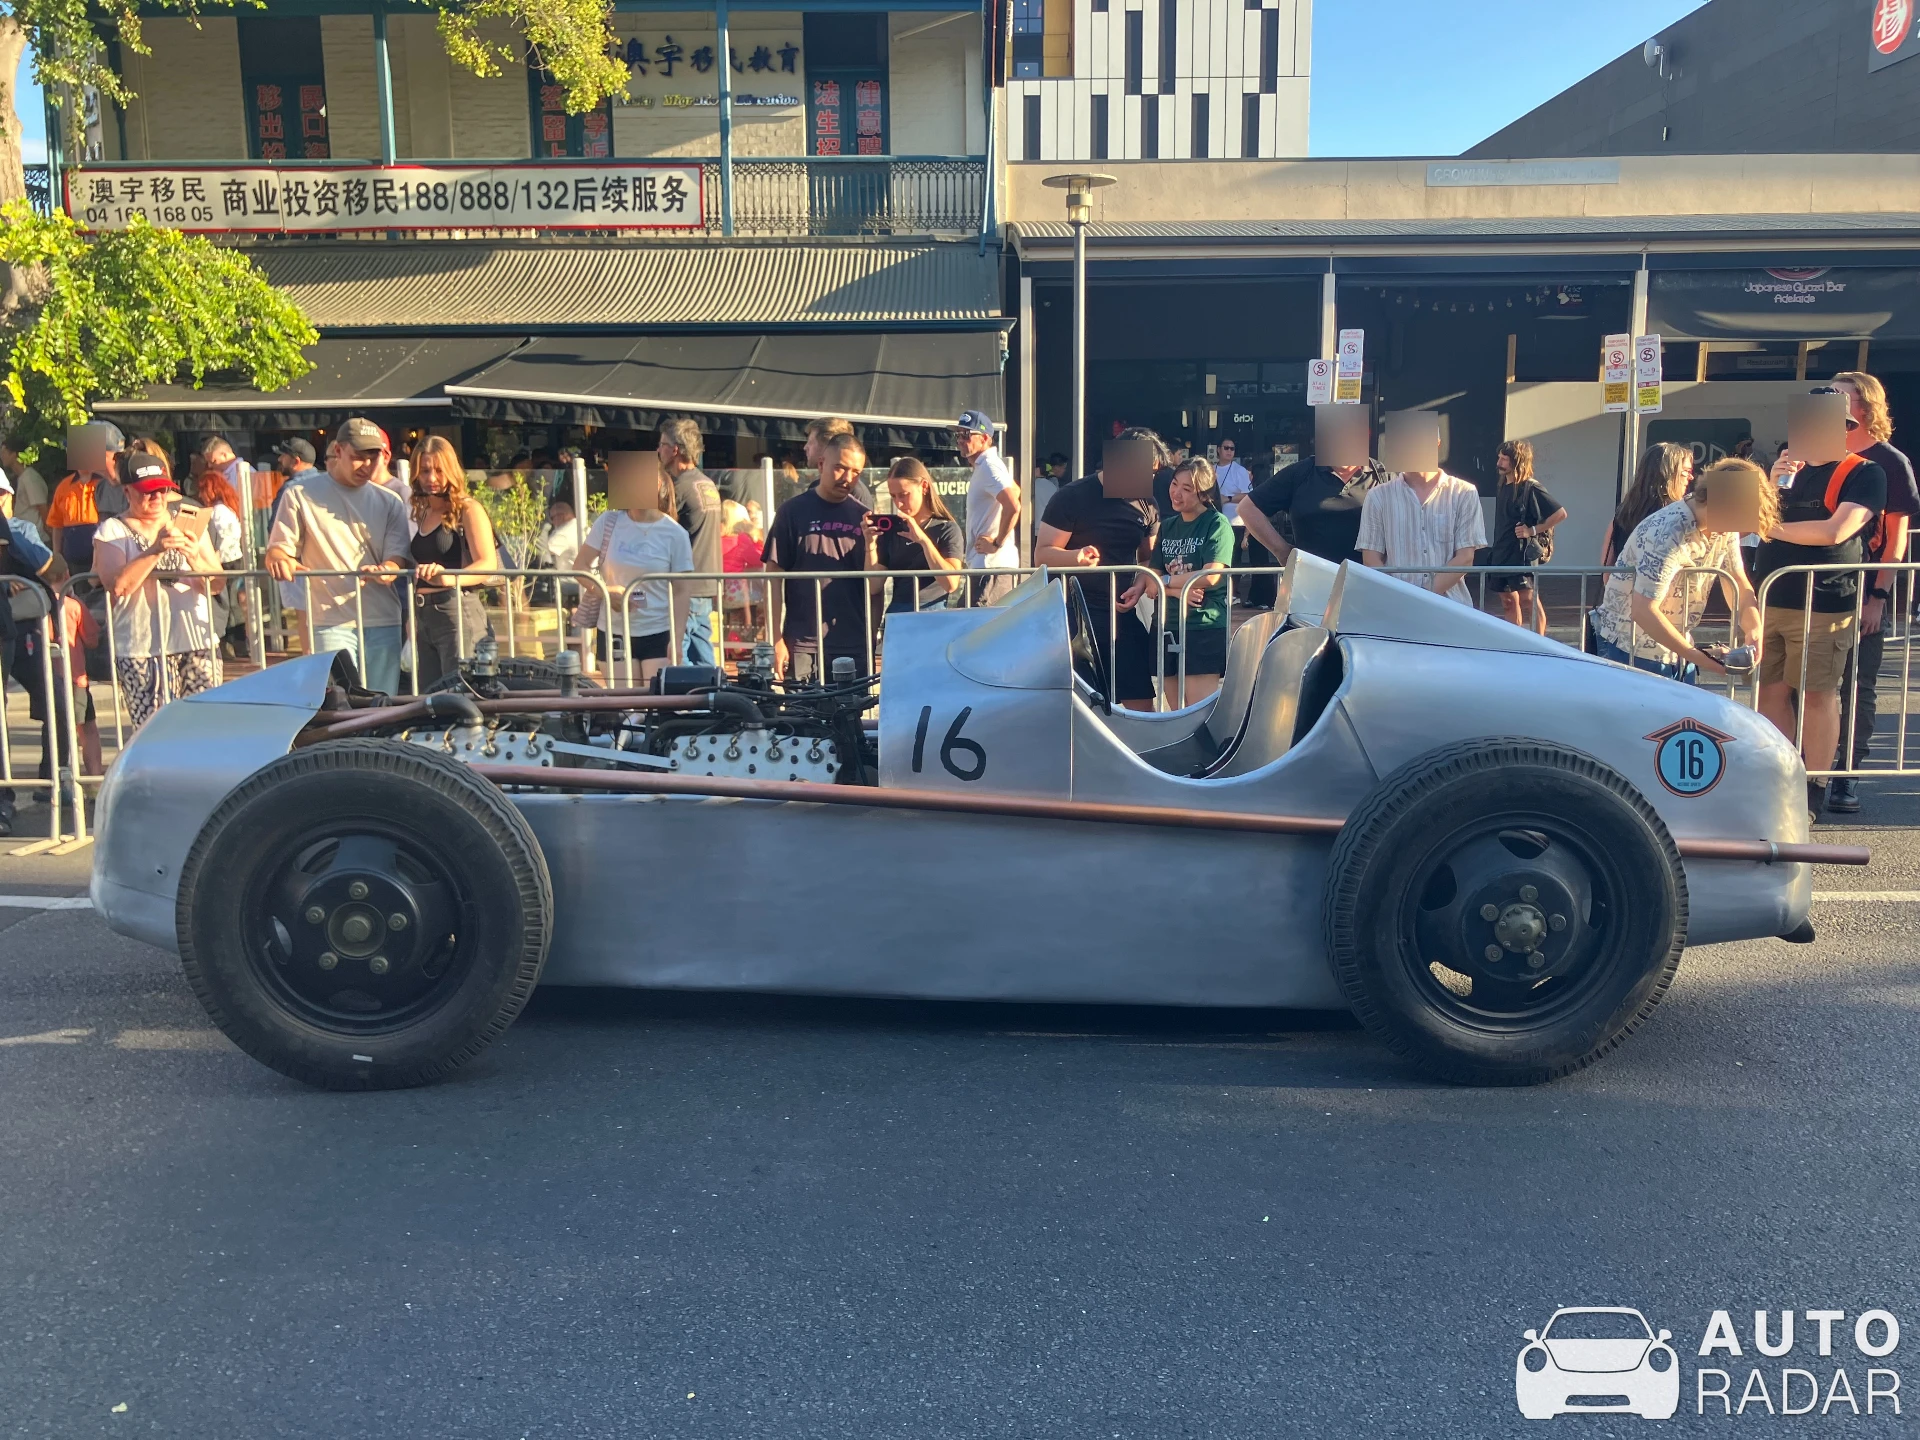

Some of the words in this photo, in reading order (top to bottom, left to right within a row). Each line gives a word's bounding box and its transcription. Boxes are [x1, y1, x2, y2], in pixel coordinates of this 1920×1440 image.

[88, 177, 207, 203] 澳宇移民
[86, 208, 109, 223] 04
[153, 206, 186, 222] 168
[191, 206, 214, 222] 05
[1745, 282, 1792, 294] Japanese
[1826, 281, 1846, 293] Bar
[1774, 294, 1816, 304] Adelaide
[912, 706, 986, 781] 16
[1675, 739, 1703, 780] 16
